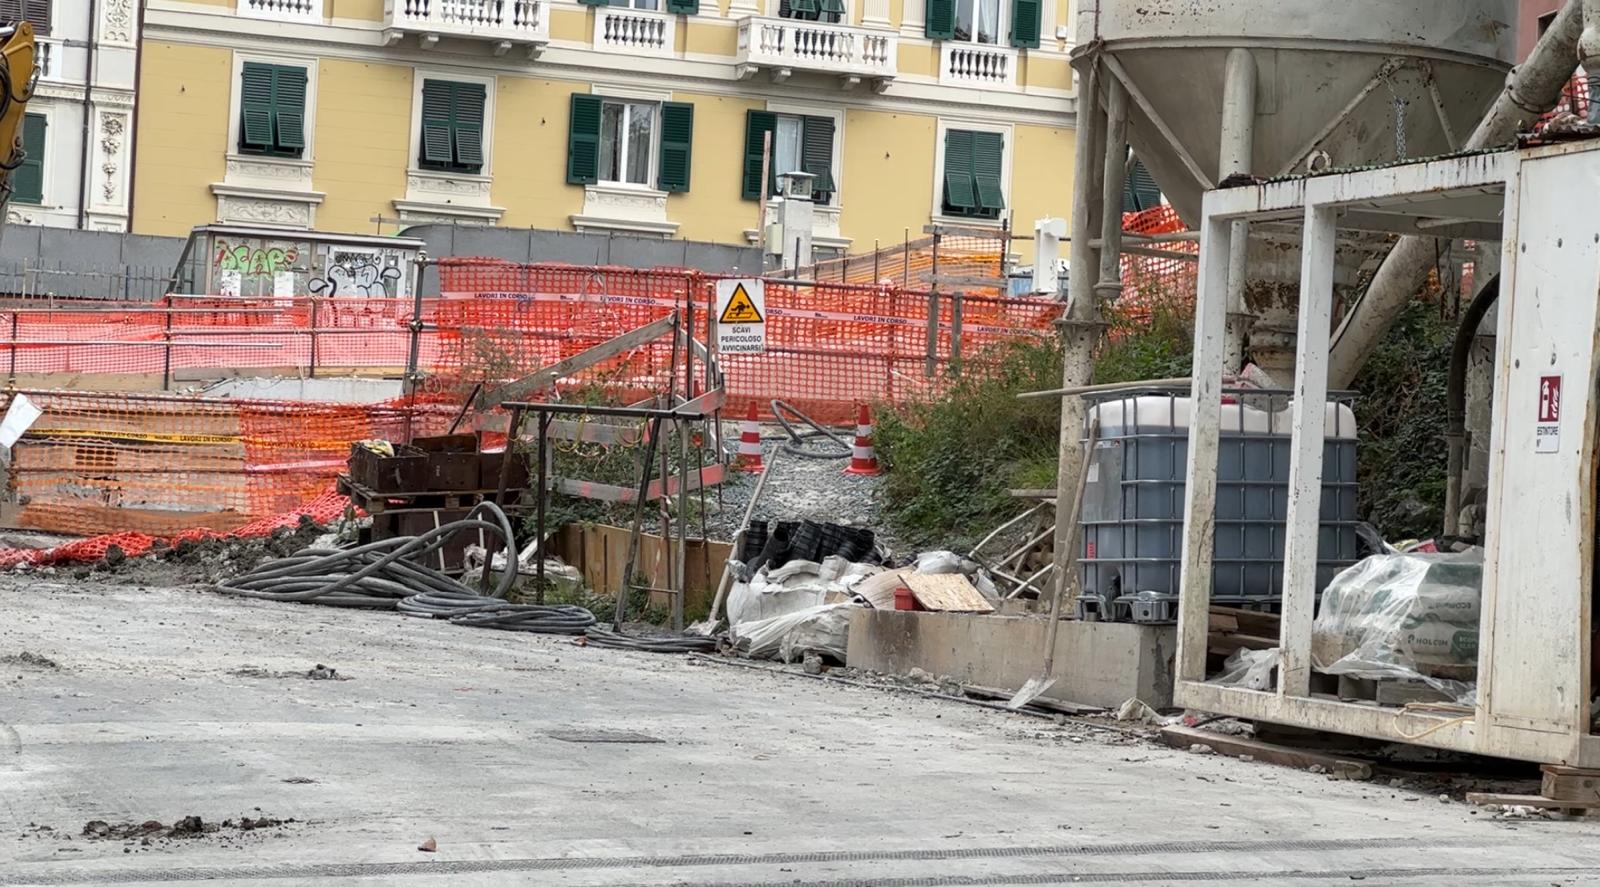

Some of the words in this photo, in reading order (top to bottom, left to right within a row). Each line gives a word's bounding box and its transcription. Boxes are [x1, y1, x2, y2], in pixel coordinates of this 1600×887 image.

[720, 335, 762, 343] PERICOLOSO
[721, 344, 761, 352] AVVICINARSI
[1416, 637, 1449, 647] HOLCIM
